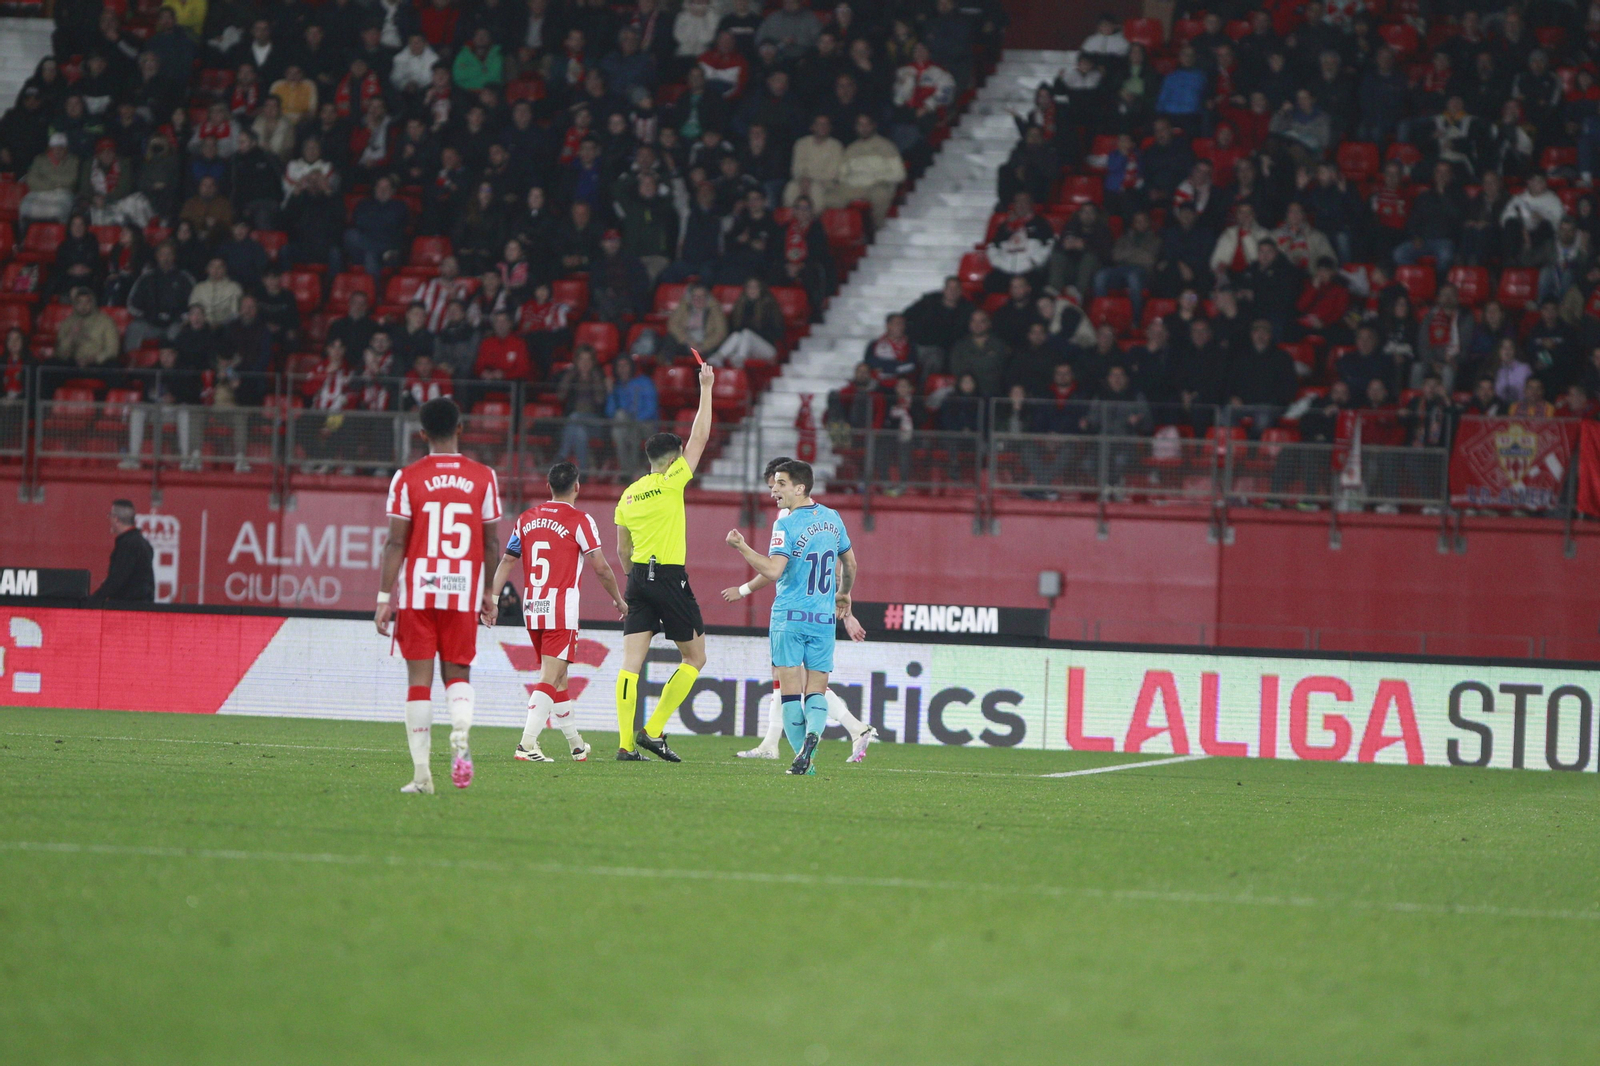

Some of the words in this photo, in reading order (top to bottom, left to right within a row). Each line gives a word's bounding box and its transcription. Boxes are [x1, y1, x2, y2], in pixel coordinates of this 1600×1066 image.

[424, 474, 475, 494] LOZANO
[633, 488, 662, 502] WÜRTH
[421, 501, 474, 559] 15
[521, 518, 570, 538] ROBERTONE
[806, 520, 841, 551] GALARR
[529, 540, 551, 588] 5
[805, 549, 836, 596] 16
[224, 571, 342, 604] CIUDAD
[442, 575, 466, 584] POWER
[442, 583, 466, 592] HORSE
[884, 604, 998, 634] #FANCAM
[1066, 665, 1425, 766] LALIGA
[1447, 680, 1600, 772] STO
